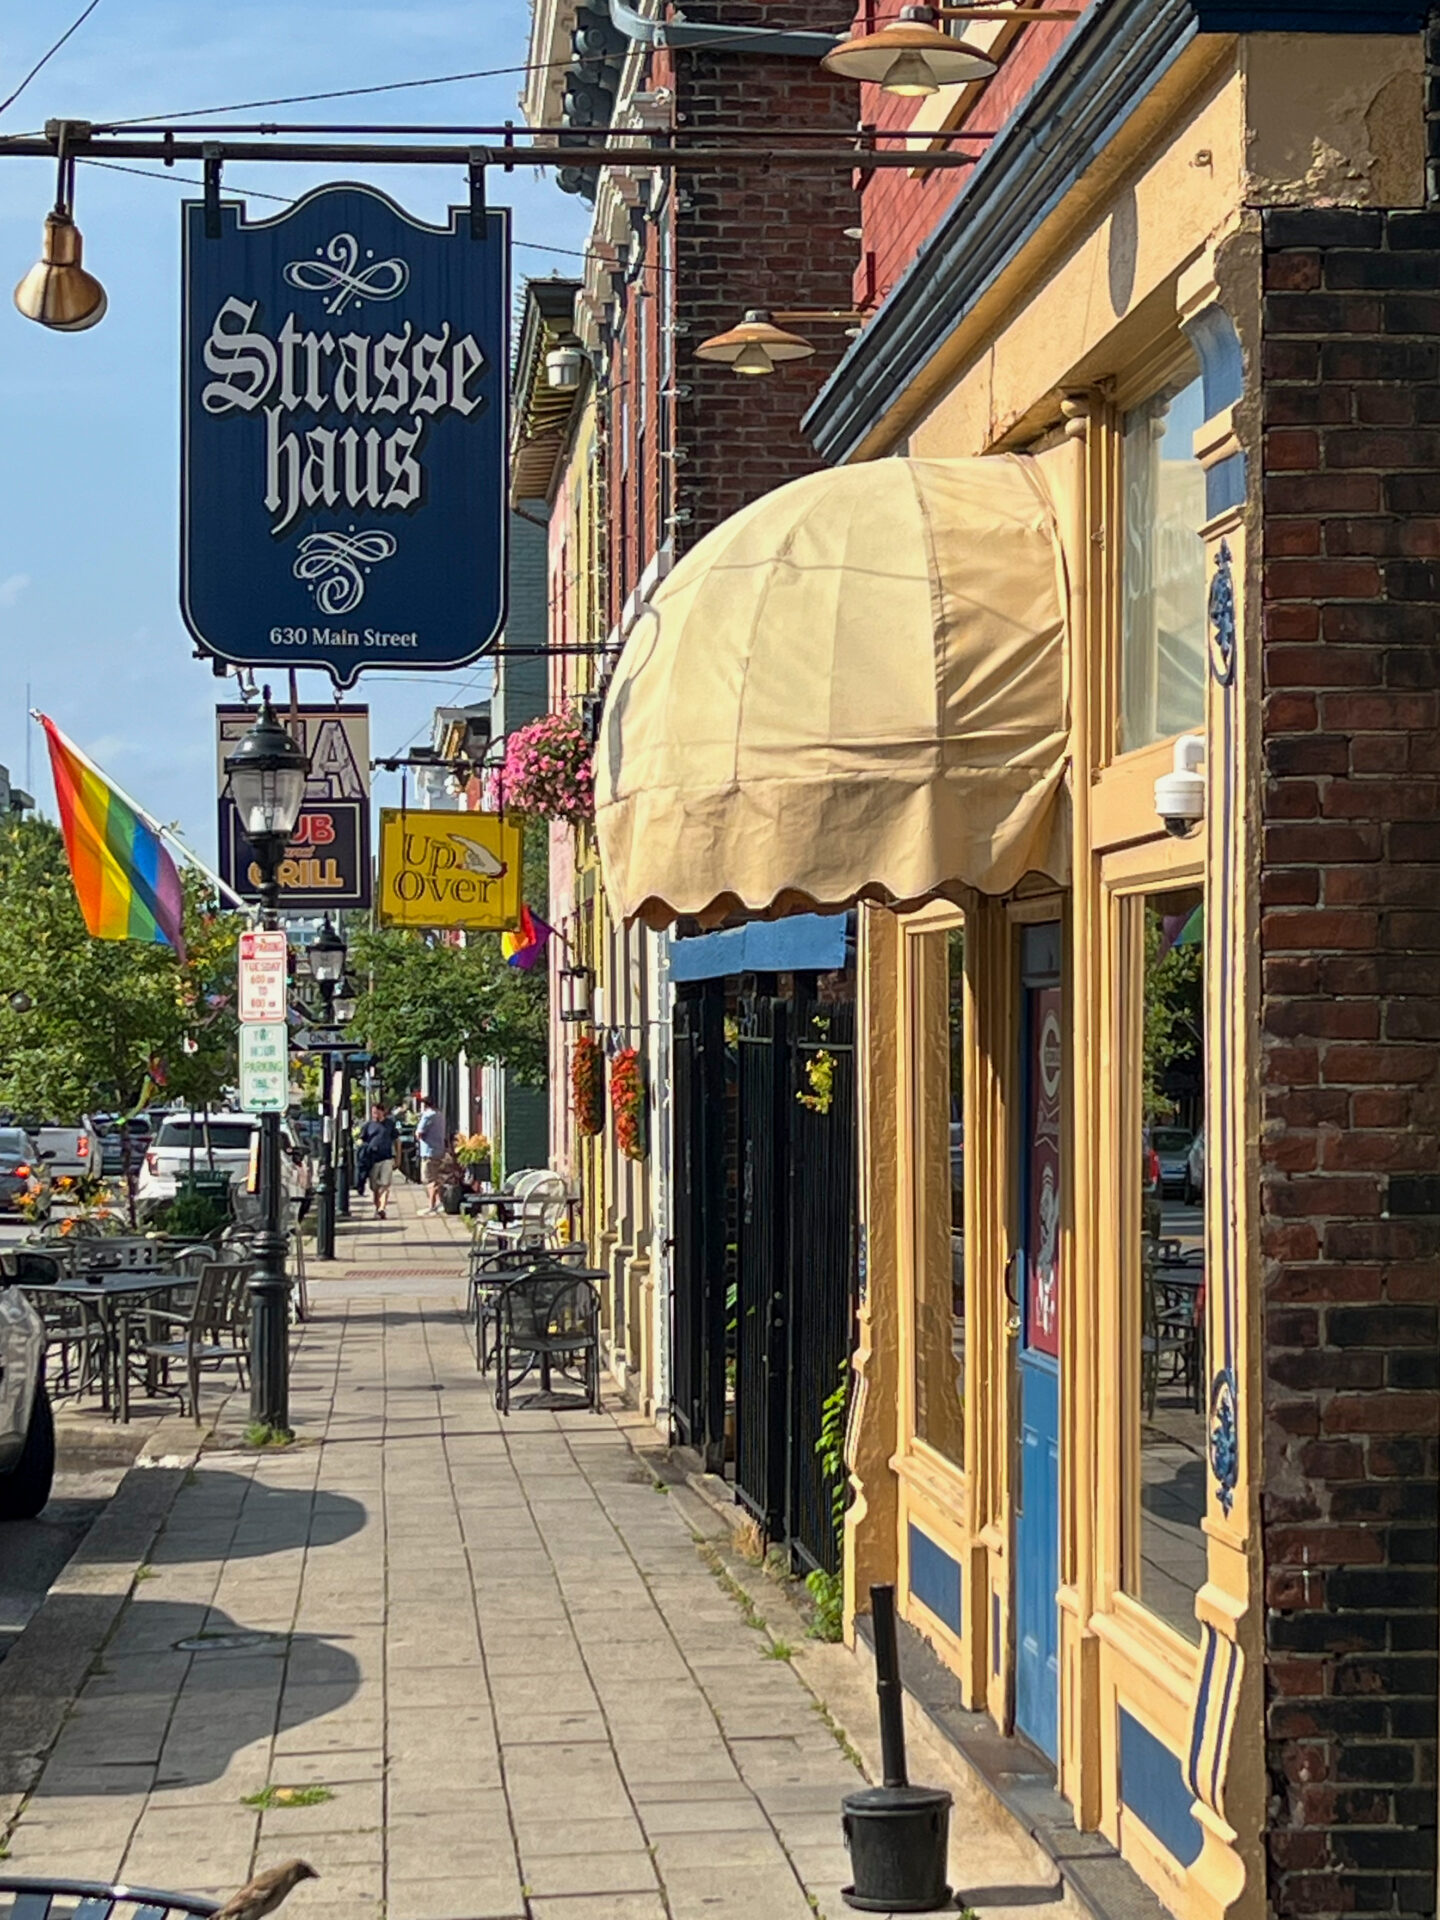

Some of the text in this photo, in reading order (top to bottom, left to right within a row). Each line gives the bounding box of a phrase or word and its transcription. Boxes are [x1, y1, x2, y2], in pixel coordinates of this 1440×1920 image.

[202, 296, 485, 416] Strasse
[263, 403, 422, 535] haus
[269, 627, 418, 647] 630 Main Street
[288, 813, 336, 844] UB
[403, 832, 457, 877] Up
[392, 870, 497, 904] Over
[244, 962, 281, 972] TUESDAY
[243, 1060, 283, 1073] PARKING
